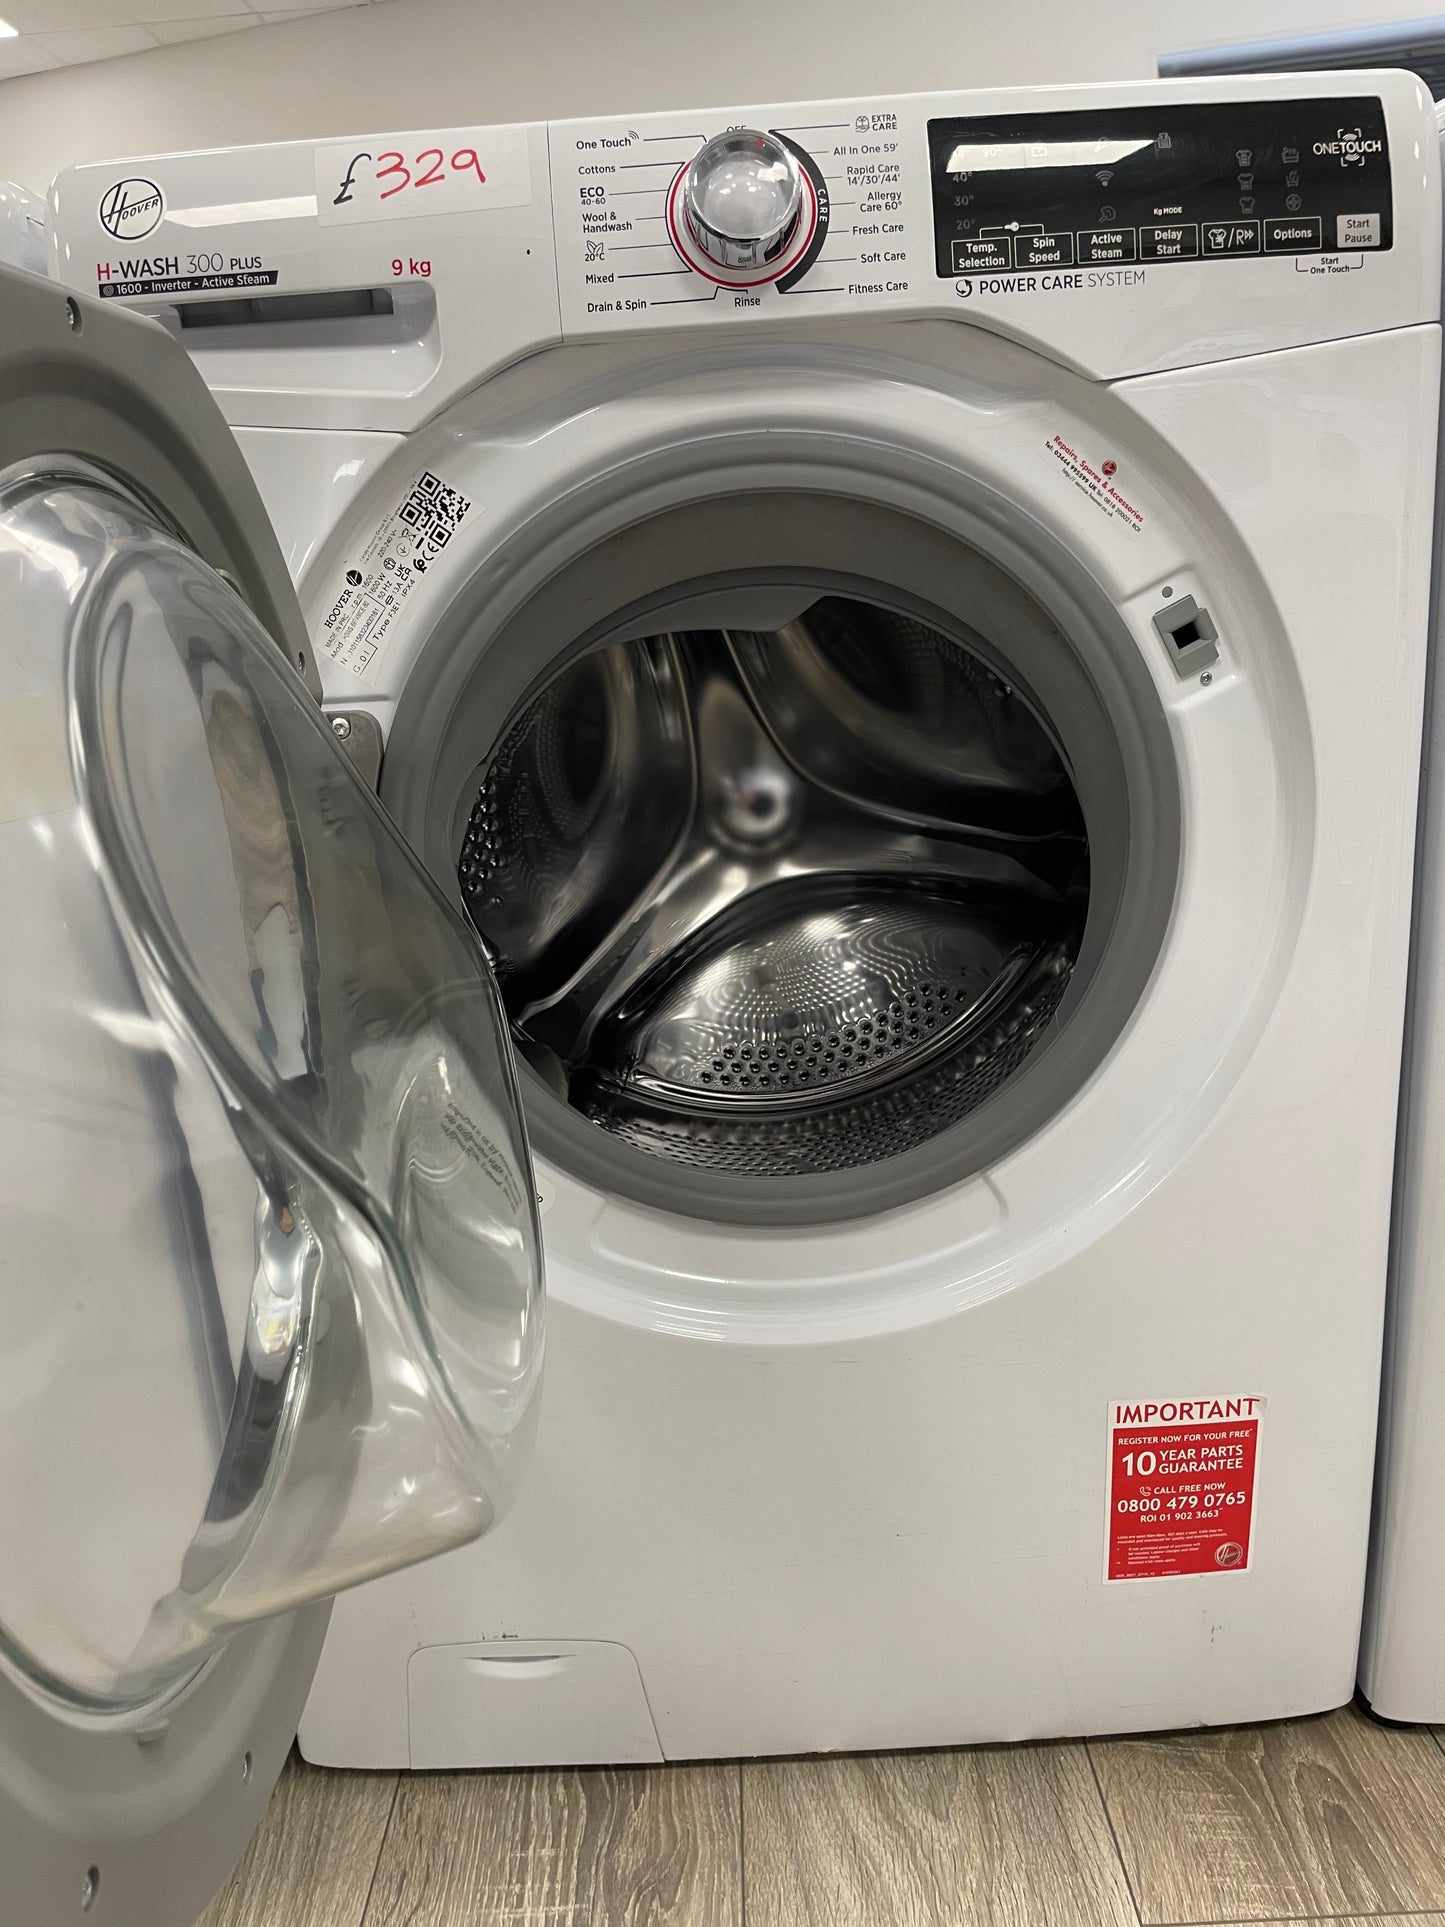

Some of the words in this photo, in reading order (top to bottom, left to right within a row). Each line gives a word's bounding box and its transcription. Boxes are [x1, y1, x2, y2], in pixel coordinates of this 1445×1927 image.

[872, 114, 897, 122] EXTRA
[872, 122, 897, 131] CARE
[576, 140, 597, 149] One
[600, 138, 631, 148] Touch
[1313, 140, 1382, 155] ONETOUCH
[834, 147, 846, 155] All
[850, 146, 858, 154] In
[861, 145, 880, 154] One
[579, 165, 616, 175] Cottons
[847, 166, 875, 175] Rapid
[878, 164, 899, 172] Care
[333, 149, 486, 204] £329
[580, 187, 604, 198] ECO
[867, 191, 901, 201] Allergy
[103, 185, 161, 234] HOOVER
[817, 189, 827, 222] CARE
[860, 203, 882, 212] Care
[1164, 206, 1182, 214] MODE
[582, 213, 607, 223] Wool
[610, 212, 617, 220] &
[583, 222, 632, 233] Handwash
[852, 225, 879, 235] Fresh
[882, 224, 904, 233] Care
[1347, 219, 1370, 229] Start
[1091, 234, 1122, 245] Active
[1154, 229, 1183, 242] Delay
[1274, 228, 1312, 241] Options
[1345, 232, 1373, 243] Pause
[966, 243, 997, 254] Temp.
[1033, 237, 1055, 248] Spin
[1092, 249, 1122, 259] Steam
[1156, 243, 1181, 255] Start
[861, 253, 881, 263] Soft
[884, 252, 906, 261] Care
[959, 256, 1005, 268] Selection
[1029, 251, 1060, 263] Speed
[1321, 257, 1339, 265] Start
[97, 256, 179, 281] H-WASH
[186, 253, 224, 273] 300
[230, 256, 262, 271] PLUS
[392, 260, 402, 276] 9
[408, 258, 431, 277] kg
[1310, 266, 1325, 274] One
[1328, 264, 1349, 273] Touch
[116, 282, 142, 294] 1600
[152, 279, 192, 292] Inverter
[202, 275, 233, 287] Active
[235, 273, 270, 285] Steam
[586, 274, 614, 284] Mixed
[979, 277, 1036, 294] POWER
[1041, 275, 1083, 290] CARE
[1088, 270, 1145, 288] SYSTEM
[848, 283, 883, 294] Fitness
[886, 281, 908, 291] Care
[587, 302, 613, 312] Drain
[616, 301, 622, 310] &
[626, 299, 647, 311] Spin
[734, 297, 760, 307] Rinse
[1054, 450, 1071, 466] 03444
[1088, 482, 1097, 491] UK
[1053, 435, 1077, 463] Repairs,
[1080, 460, 1101, 483] Spares
[1102, 481, 1108, 489] &
[1107, 488, 1143, 522] Accessories
[362, 574, 374, 589] 1600
[369, 580, 380, 595] 1600
[377, 572, 385, 581] W
[377, 591, 386, 599] 50
[382, 580, 392, 592] Hz
[392, 582, 403, 594] 13A
[401, 579, 415, 597] IPX4
[324, 589, 353, 629] HOOVER
[372, 619, 390, 640] Type
[388, 602, 400, 618] F3E1
[1116, 1398, 1260, 1424] IMPORTANT
[1118, 1437, 1158, 1445] REGISTER
[1161, 1435, 1181, 1443] NOW
[1184, 1434, 1201, 1442] FOR
[1204, 1432, 1227, 1440] YOUR
[1159, 1448, 1195, 1460] YEAR
[1201, 1445, 1243, 1458] PARTS
[1122, 1451, 1157, 1476] 10
[1159, 1458, 1243, 1474] GUARANTEE
[1154, 1487, 1176, 1495] CALL
[1179, 1485, 1201, 1493] FREE
[1204, 1483, 1226, 1491] NOW
[1117, 1498, 1161, 1513] 0800
[1167, 1495, 1198, 1510] 479
[1204, 1492, 1246, 1507] 0765
[1175, 1512, 1192, 1520] 902
